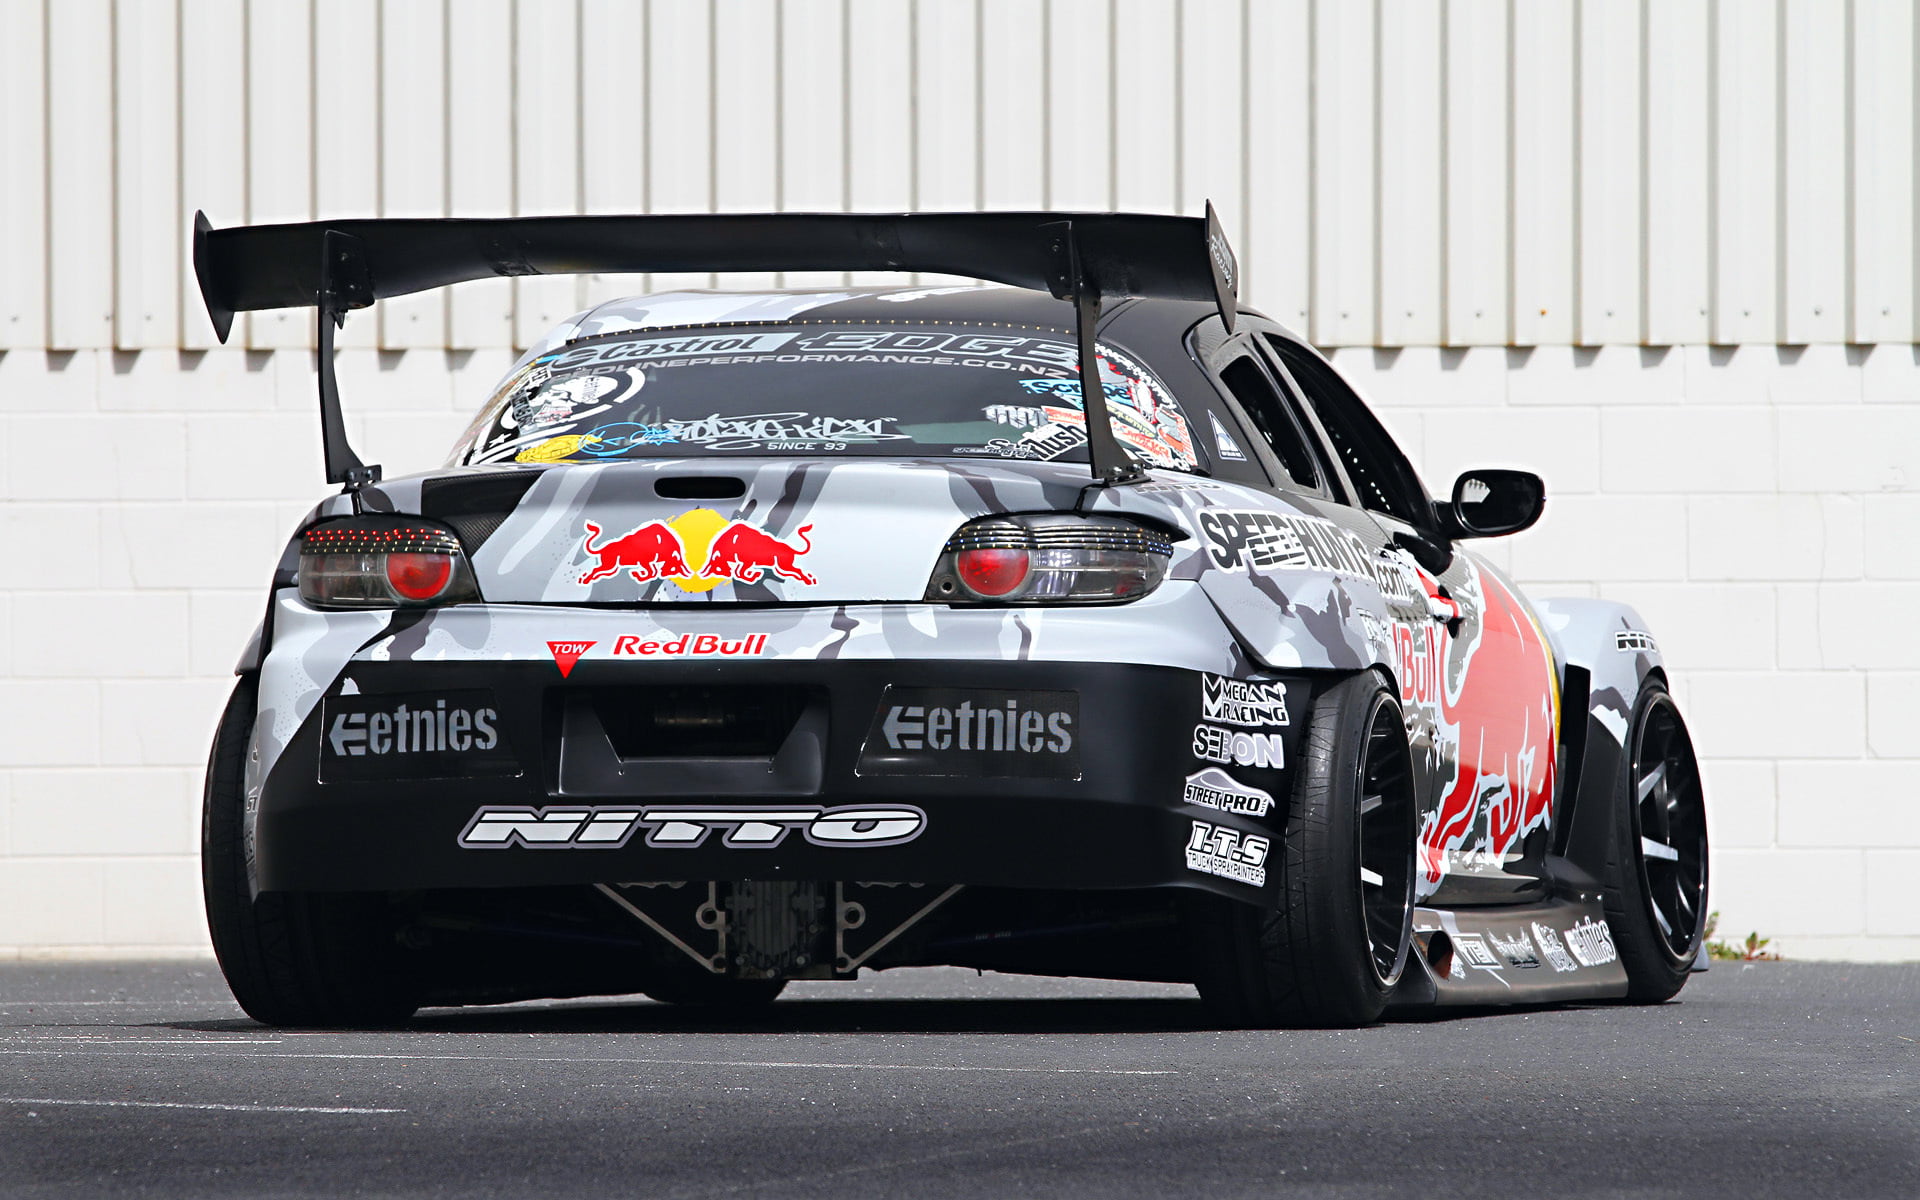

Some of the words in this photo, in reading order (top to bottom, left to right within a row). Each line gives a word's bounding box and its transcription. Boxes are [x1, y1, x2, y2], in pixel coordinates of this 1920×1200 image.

[599, 334, 756, 360] Castrol
[797, 332, 1079, 367] EDGE
[767, 441, 818, 451] SINCE
[824, 442, 847, 451] 93
[553, 642, 587, 655] TOW
[612, 634, 690, 656] Red
[692, 634, 768, 656] Bull
[1222, 682, 1283, 703] MEGAN
[1223, 702, 1288, 722] RACING
[369, 698, 499, 756] etnies
[927, 699, 1073, 754] etnies
[1185, 784, 1222, 807] STREET
[1222, 793, 1261, 812] PRO
[457, 804, 929, 848] NITTO
[1187, 851, 1213, 870] TRUCK
[1213, 858, 1265, 883] SPRAYPAINTERS
